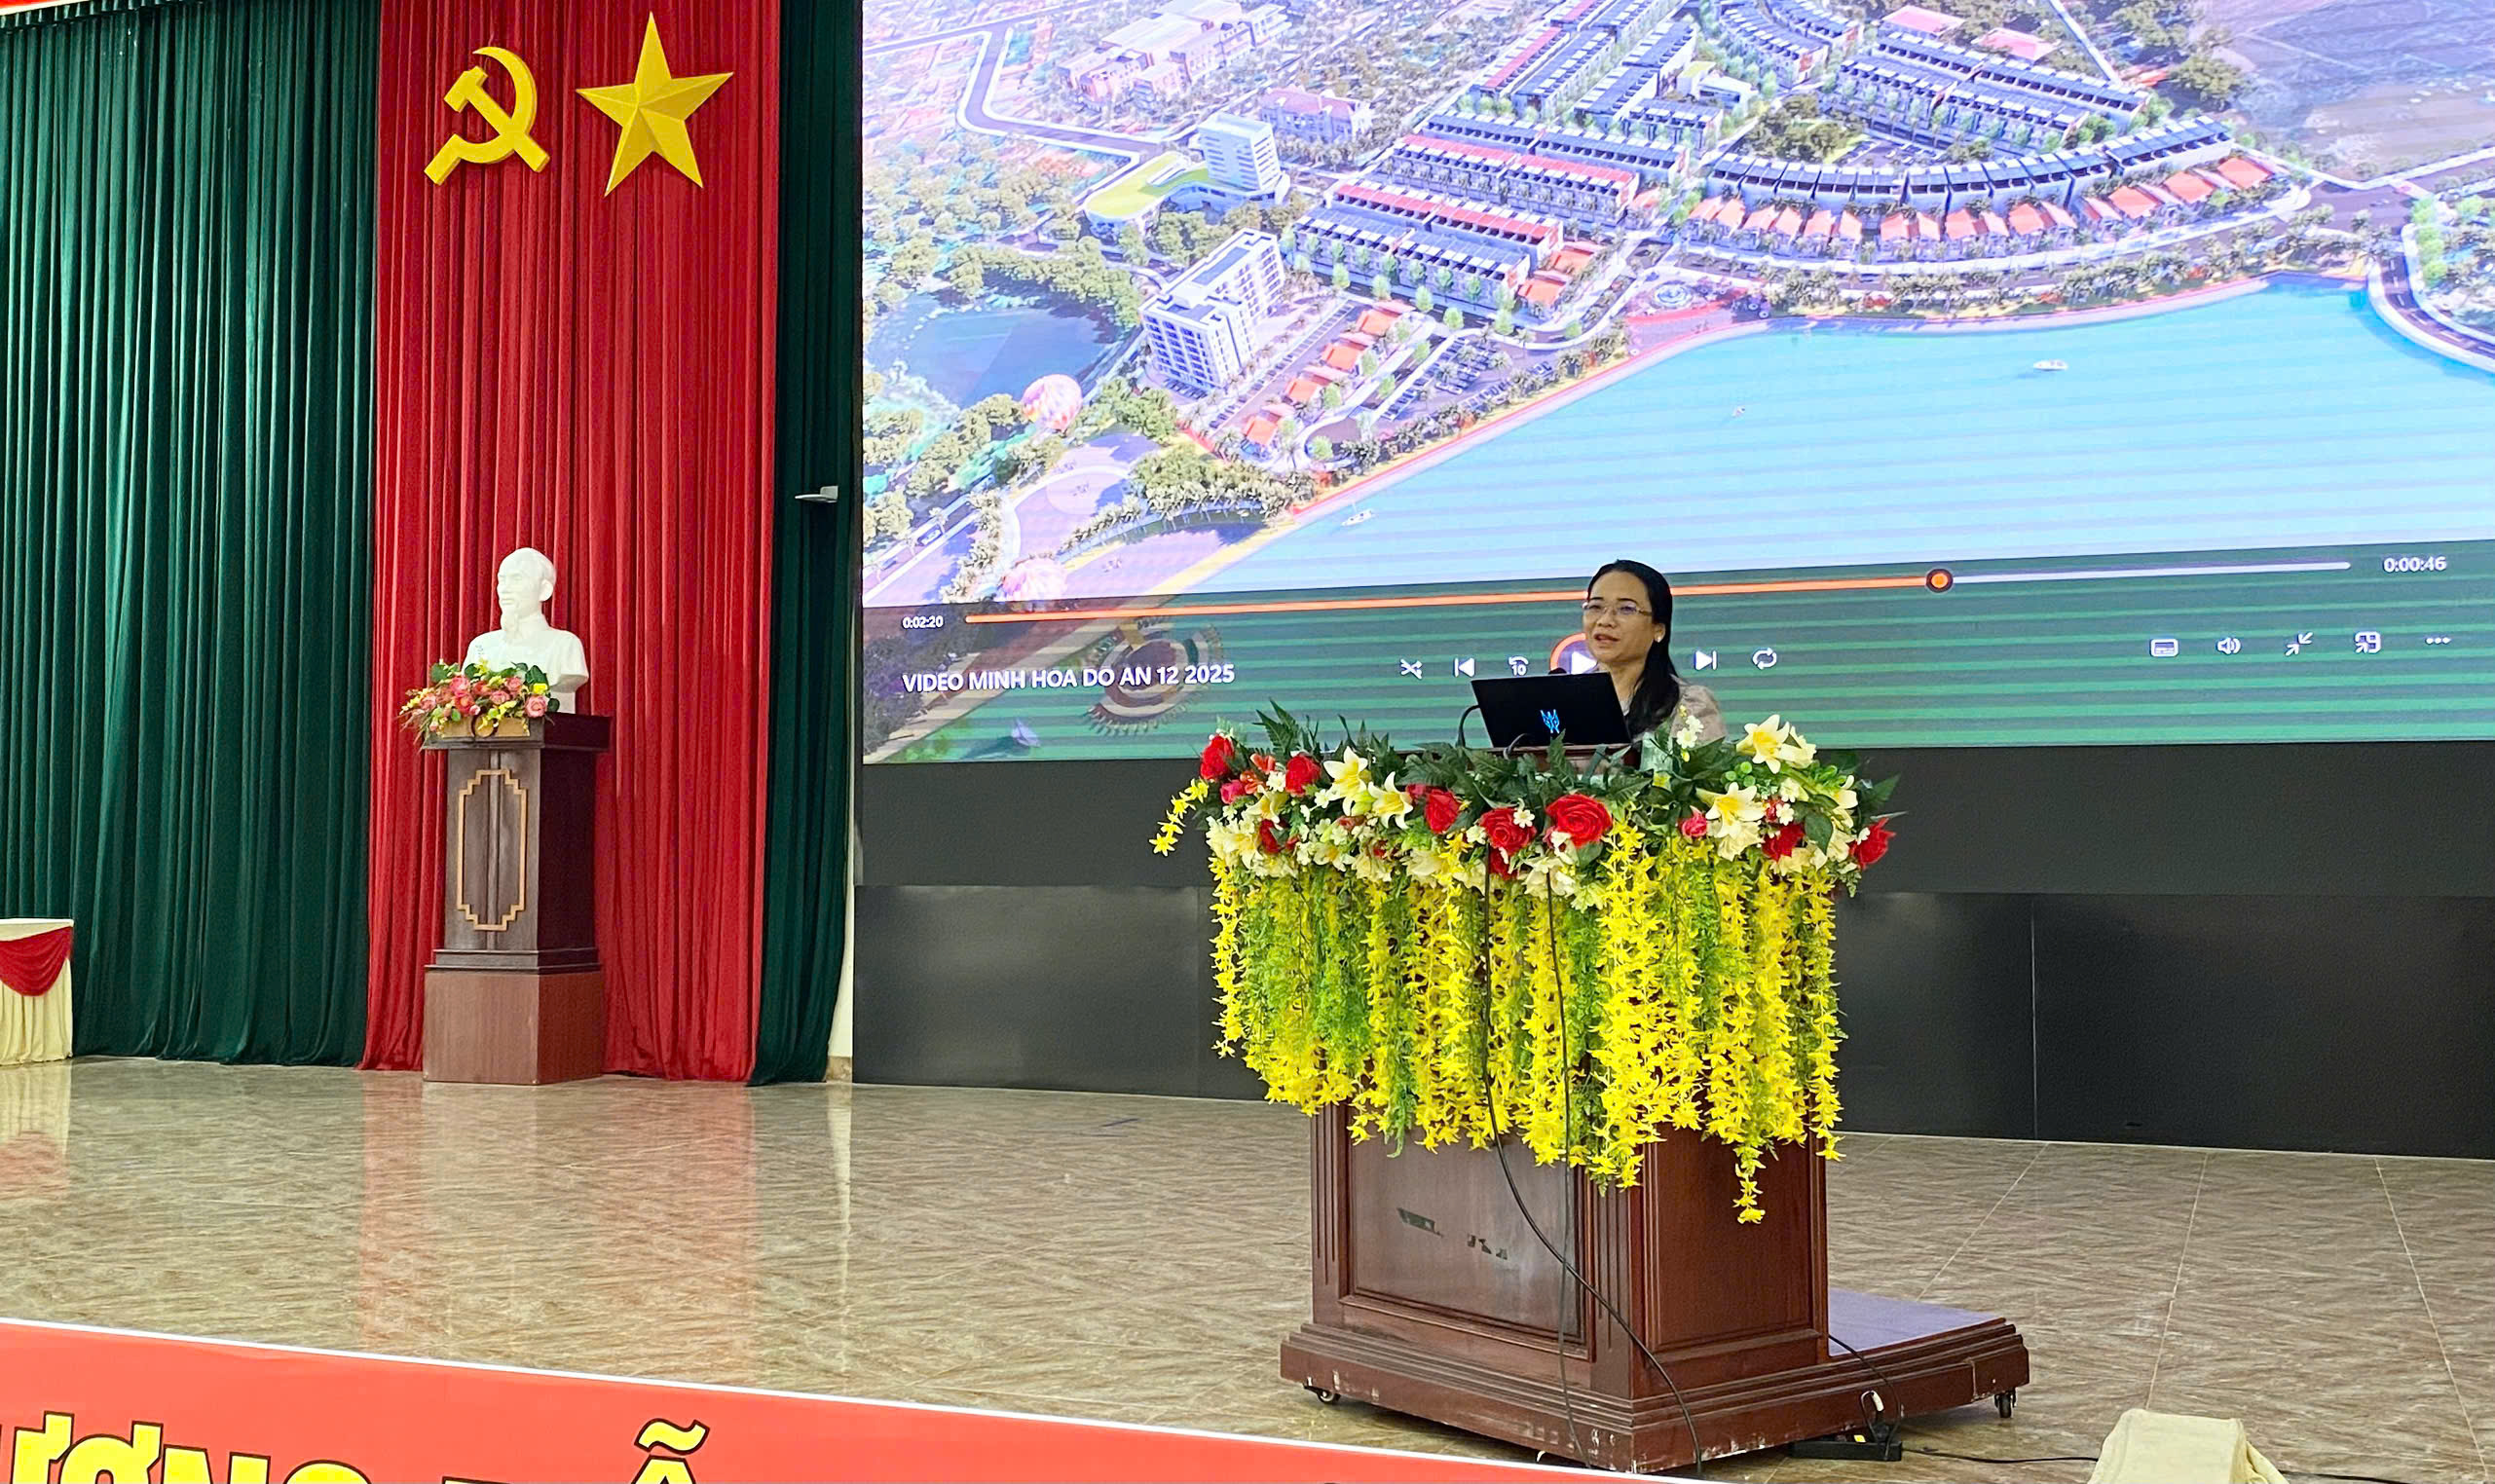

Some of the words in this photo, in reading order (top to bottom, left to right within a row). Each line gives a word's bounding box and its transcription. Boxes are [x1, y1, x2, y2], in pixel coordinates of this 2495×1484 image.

[2383, 556, 2447, 573] 0:00:46
[902, 615, 944, 629] 0:02:20
[902, 672, 964, 692] VIDEO
[968, 670, 1025, 690] MINH
[1031, 669, 1078, 688] HOA
[1083, 668, 1115, 687] DO
[1120, 666, 1152, 686] AN
[1157, 666, 1179, 686] 12
[1184, 663, 1235, 684] 2025
